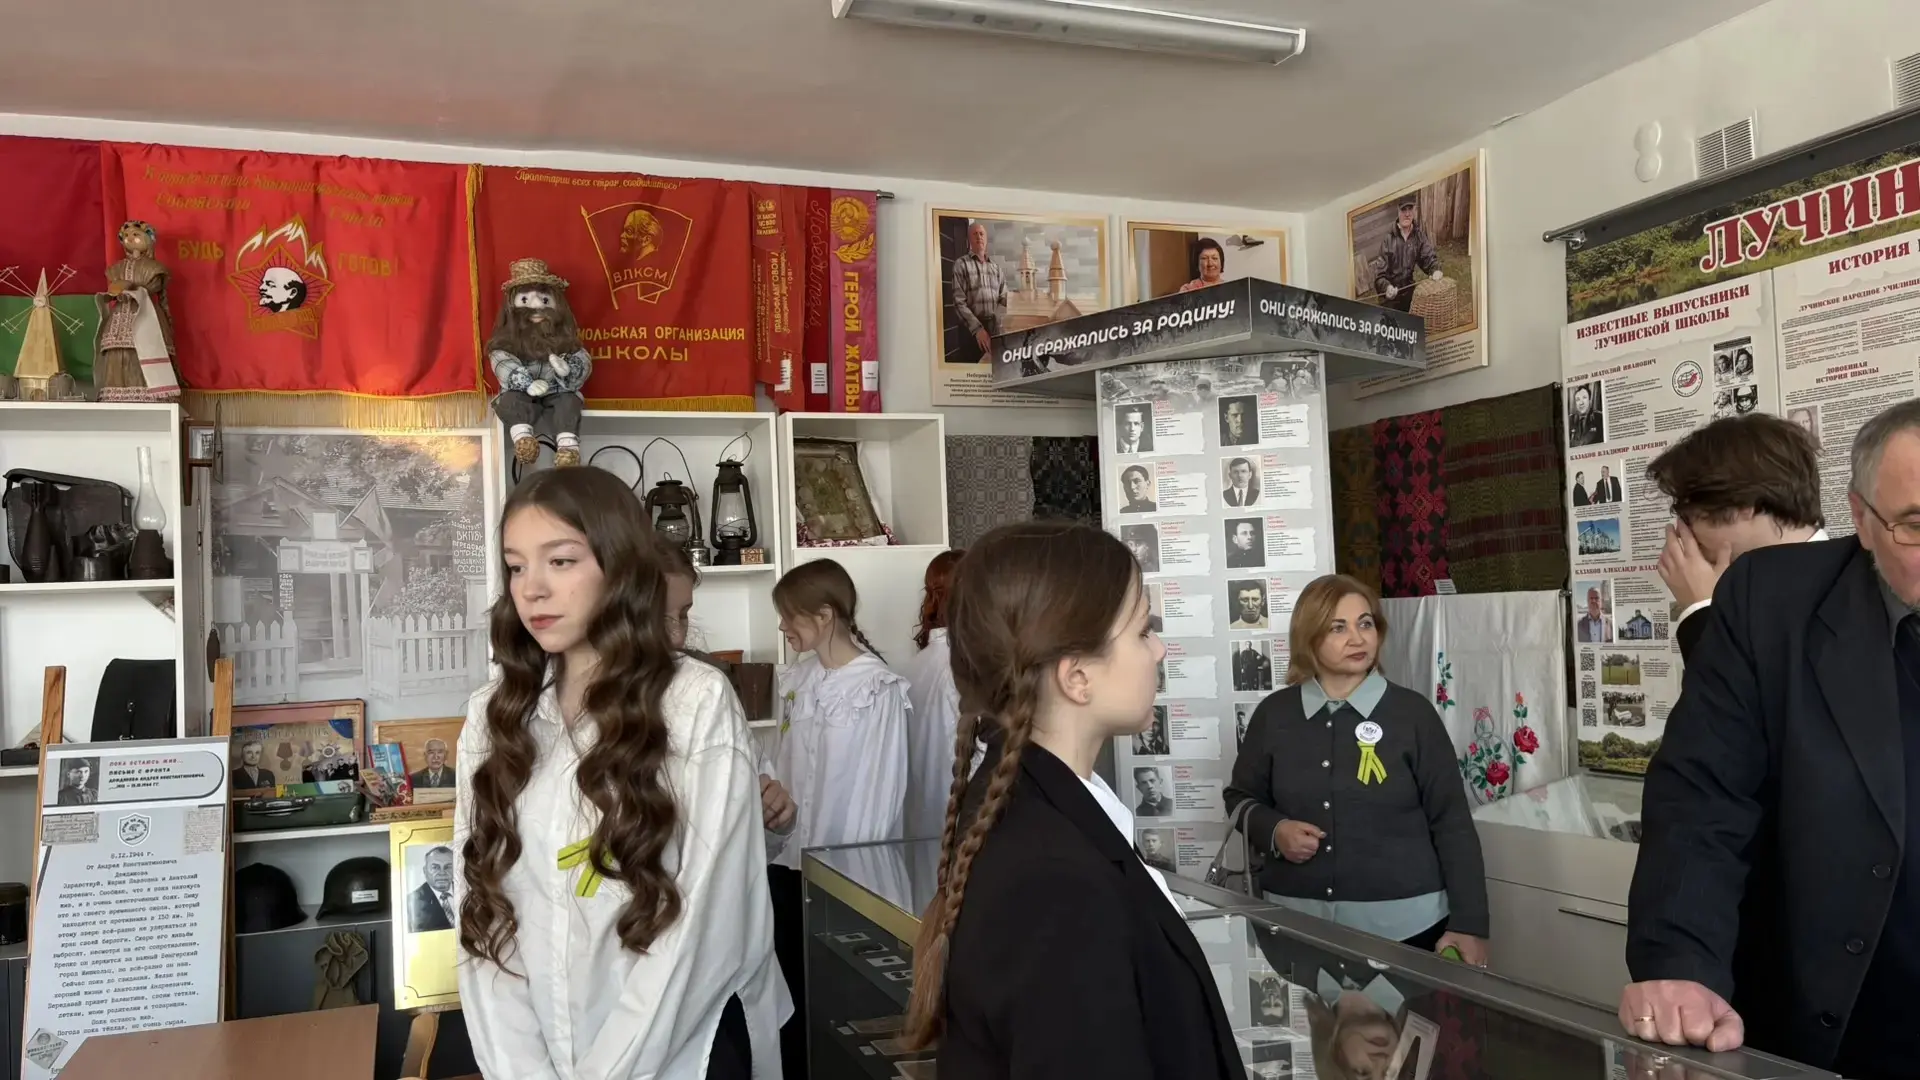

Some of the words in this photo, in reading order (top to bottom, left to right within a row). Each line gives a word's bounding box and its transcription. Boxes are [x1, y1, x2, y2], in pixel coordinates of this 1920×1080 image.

[572, 178, 590, 187] всех
[1701, 158, 1920, 271] ЛУЧИН
[178, 240, 224, 261] БУДЬ
[1828, 241, 1911, 275] ИСТОРИЯ
[612, 266, 668, 283] ВЛКСМ
[770, 258, 782, 333] ПРАВОФЛАНГОВОЙ
[844, 271, 862, 332] ГЕРОЙ
[1798, 297, 1840, 312] ЛУЧИНСКОЕ
[1843, 288, 1880, 302] НАРОДНОЕ
[1259, 298, 1286, 318] ОНИ
[1288, 304, 1357, 332] СРАЖАЛИСЬ
[1357, 319, 1372, 335] ЗА
[1373, 323, 1418, 345] РОДИНУ!
[1576, 310, 1650, 340] ИЗВЕСТНЫЕ
[1653, 283, 1751, 320] ВЫПУСКНИКИ
[576, 326, 648, 341] МОЛЬСКАЯ
[654, 325, 745, 342] ОРГАНИЗАЦИЯ
[1002, 342, 1032, 364] ОНИ
[1035, 327, 1128, 357] СРАЖАЛИСЬ
[1131, 318, 1153, 337] ЗА
[1156, 299, 1235, 331] РОДИНУ!
[1593, 318, 1671, 351] ЛУЧИНСКОЙ
[1675, 306, 1730, 333] ШКОЛЫ
[591, 345, 688, 361] ШКОЛЫ
[845, 344, 862, 412] ЖАТВЫ
[1591, 365, 1622, 379] АНАТОЛИЙ
[1623, 358, 1657, 372] ИВАНОВИЧ
[1815, 373, 1848, 384] ИСТОРИЯ
[1850, 367, 1879, 378] ШКОЛЫ
[144, 767, 171, 775] ФРОНТА
